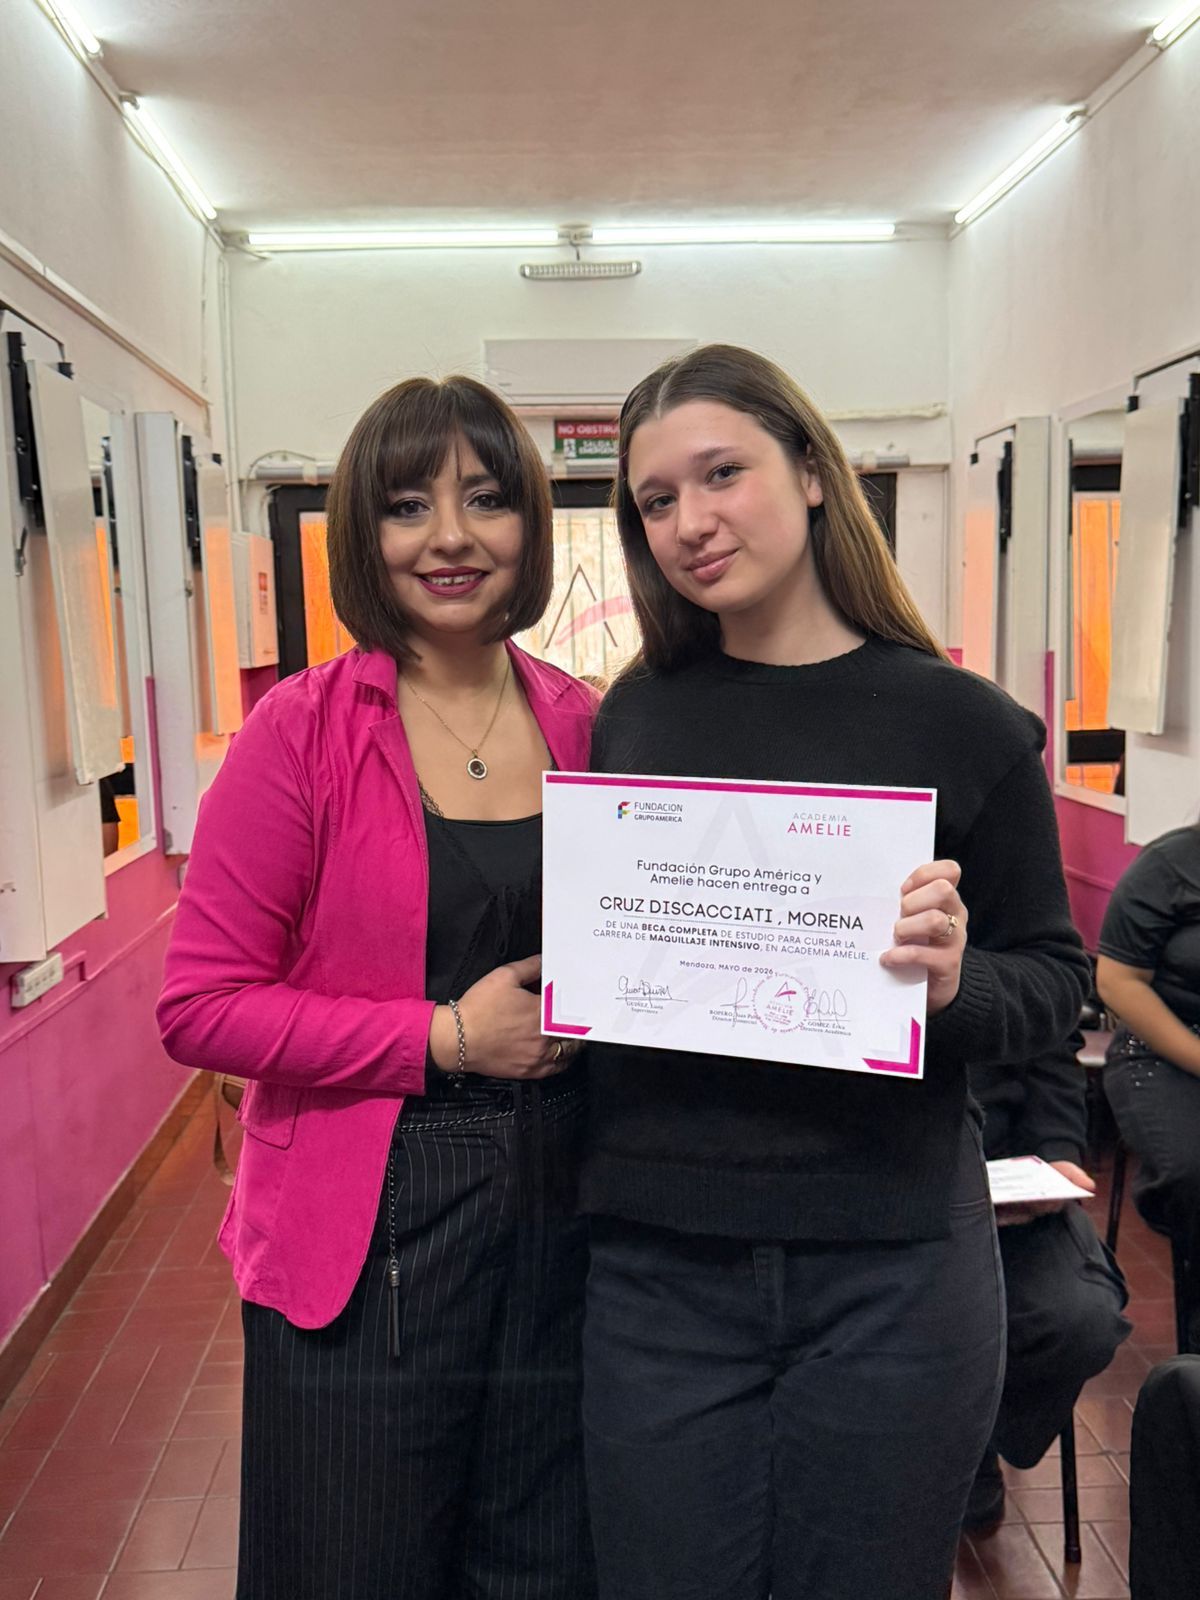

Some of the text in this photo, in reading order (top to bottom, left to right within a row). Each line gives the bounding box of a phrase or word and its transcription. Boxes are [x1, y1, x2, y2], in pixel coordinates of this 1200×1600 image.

[558, 424, 575, 434] NO
[634, 801, 683, 812] FUNDACION
[793, 812, 848, 822] ACADEMIA
[787, 822, 852, 836] AMELIE
[637, 859, 822, 885] Fundación Grupo América y
[650, 874, 810, 896] Amelie hacen entrega a
[600, 896, 645, 913] CRUZ
[650, 900, 773, 923] DISCACCIATI
[788, 911, 864, 930] MORENA
[606, 920, 856, 949] DE UNA BECA COMPLETA DE ESTUDIO PARA CURSAR LA
[593, 929, 870, 961] CARRERA DE MAQUILLAJE INTENSIVO, EN ACADEMIA AMELIE.
[680, 960, 716, 970] Mendoza,
[718, 964, 740, 972] MAYO
